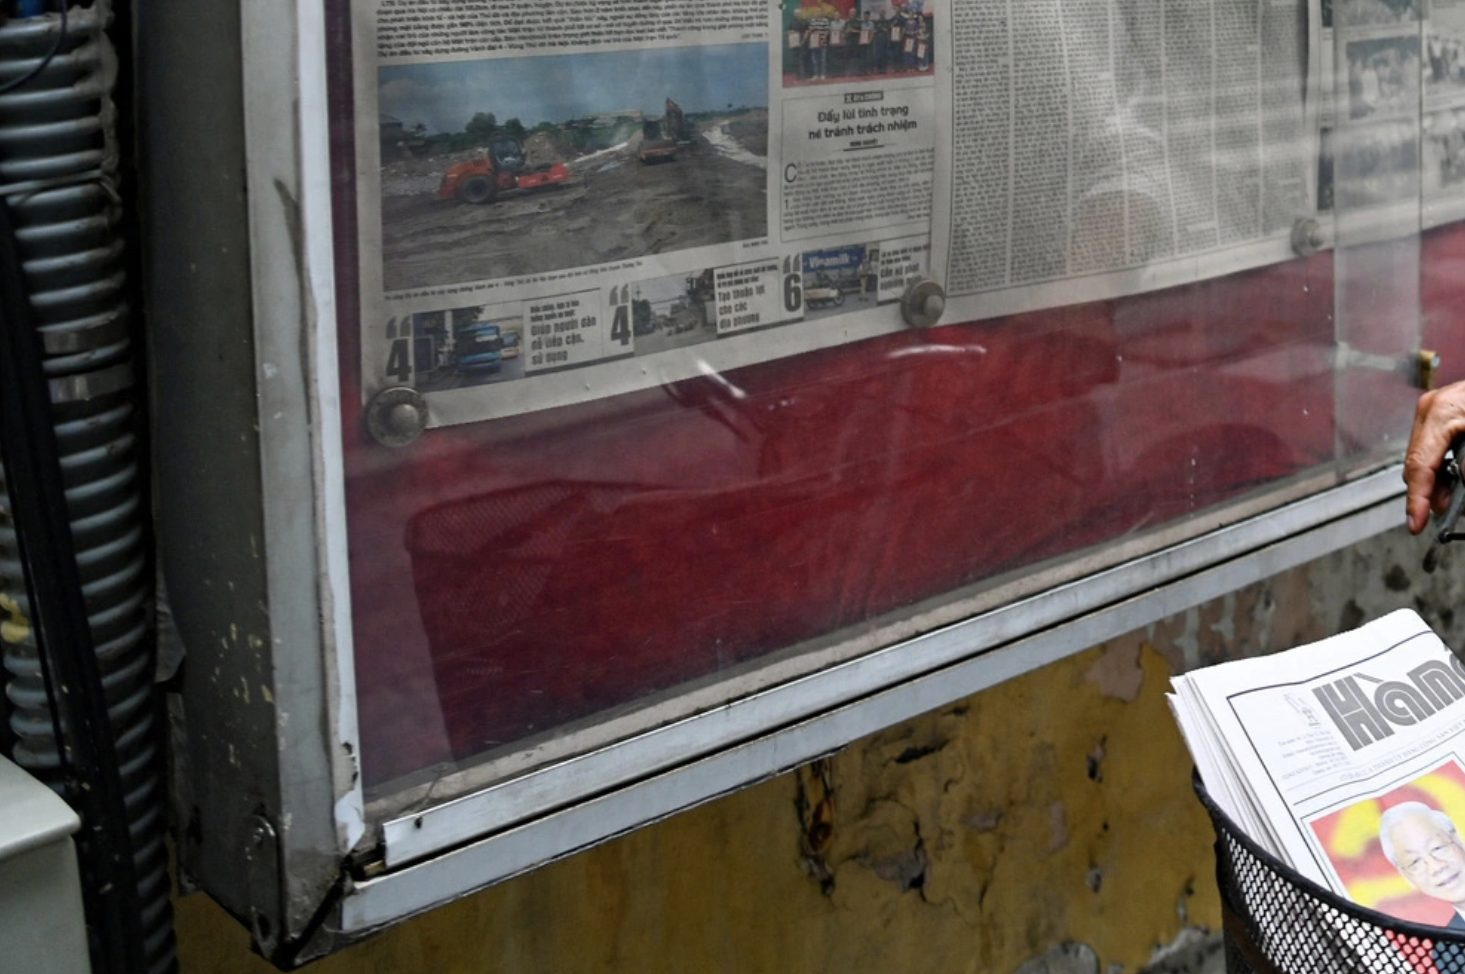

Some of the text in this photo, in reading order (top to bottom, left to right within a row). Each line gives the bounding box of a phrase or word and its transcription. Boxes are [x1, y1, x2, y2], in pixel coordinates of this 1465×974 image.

[808, 119, 918, 140] né tránh trách nhiệm
[783, 273, 802, 312] 6
[610, 304, 632, 347] 4
[386, 338, 413, 382] 4
